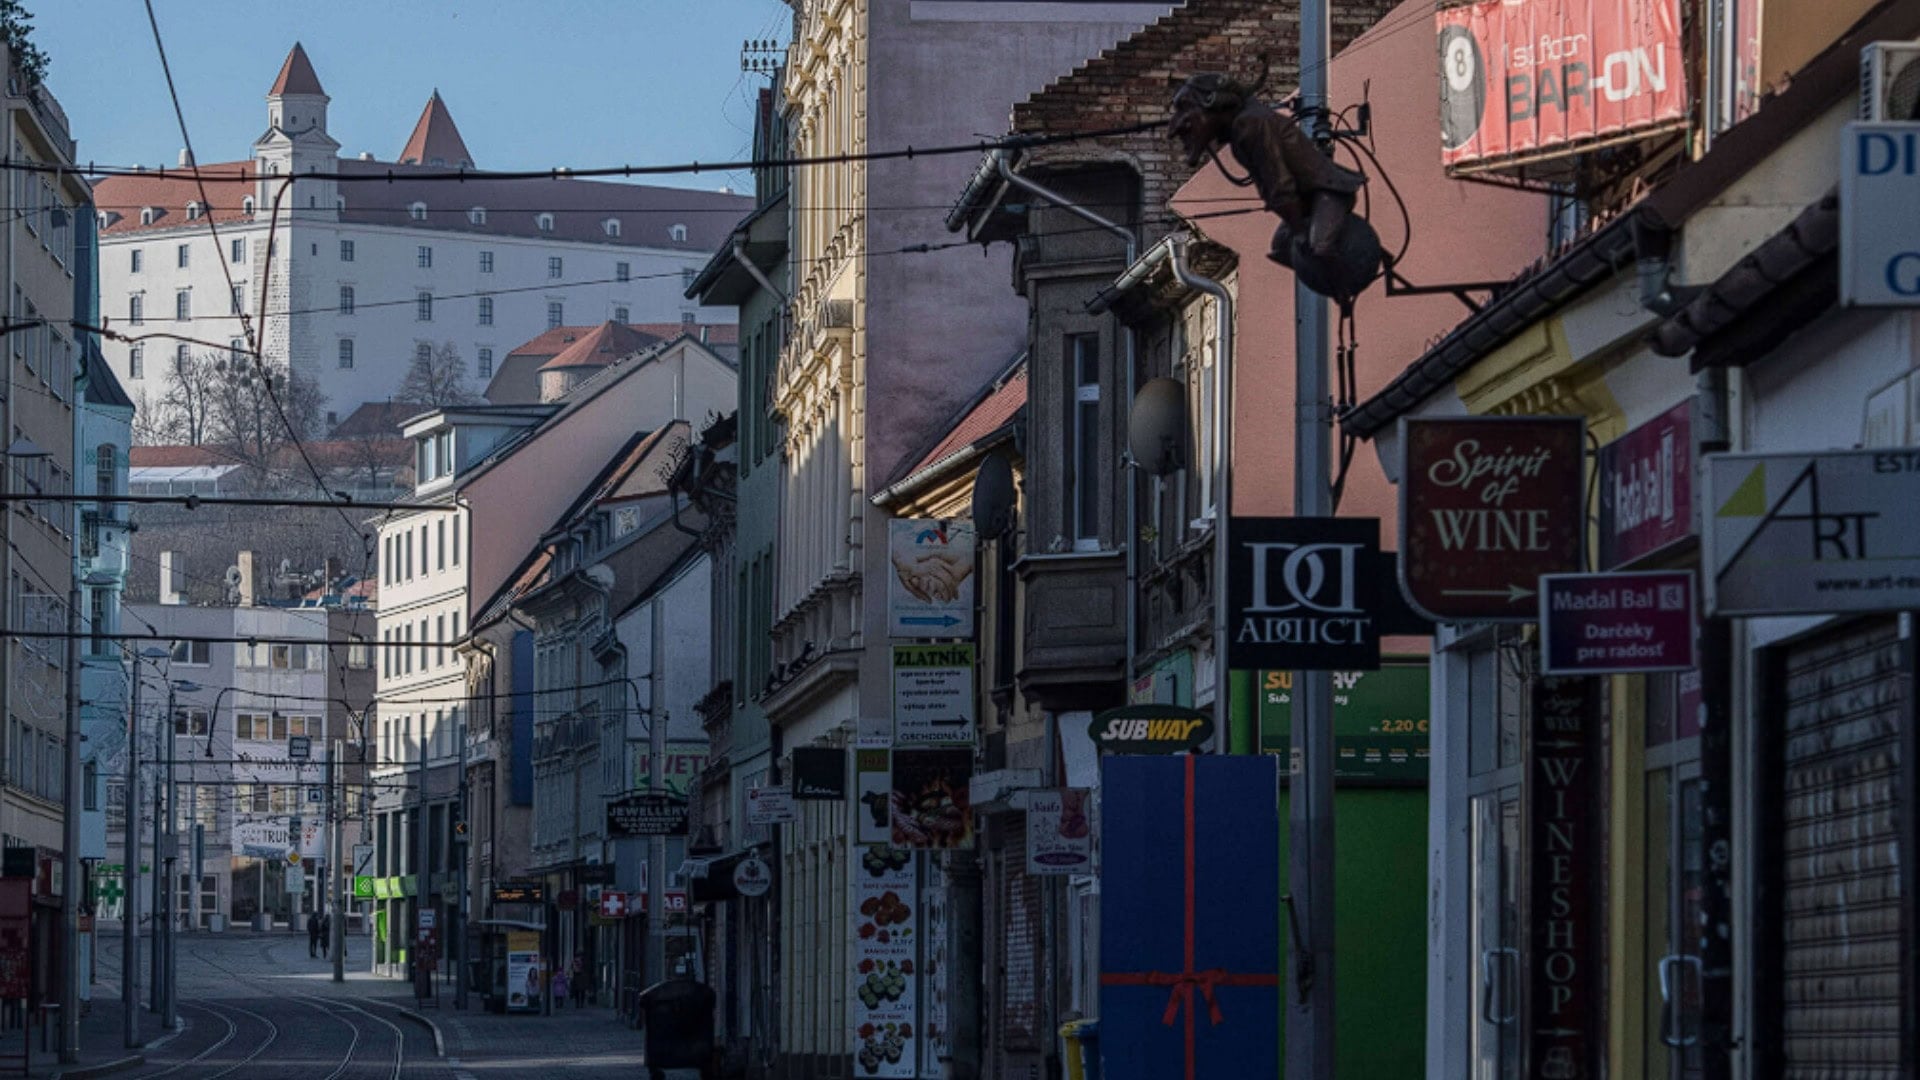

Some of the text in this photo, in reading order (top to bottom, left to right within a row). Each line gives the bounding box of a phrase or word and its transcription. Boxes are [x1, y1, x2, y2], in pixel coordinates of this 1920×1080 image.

[1454, 50, 1467, 78] 8
[1505, 42, 1667, 123] BAR-ON
[1428, 439, 1552, 491] Spirit
[1480, 474, 1520, 507] of
[1429, 508, 1551, 552] WINE
[1552, 588, 1654, 611] Madal Bal
[1236, 616, 1371, 645] ADDICT
[1577, 646, 1606, 662] pre
[1268, 692, 1291, 704] Sub
[1100, 718, 1204, 741] SUBWAY
[1381, 719, 1414, 732] 2,20
[609, 806, 689, 817] JEWELLERY
